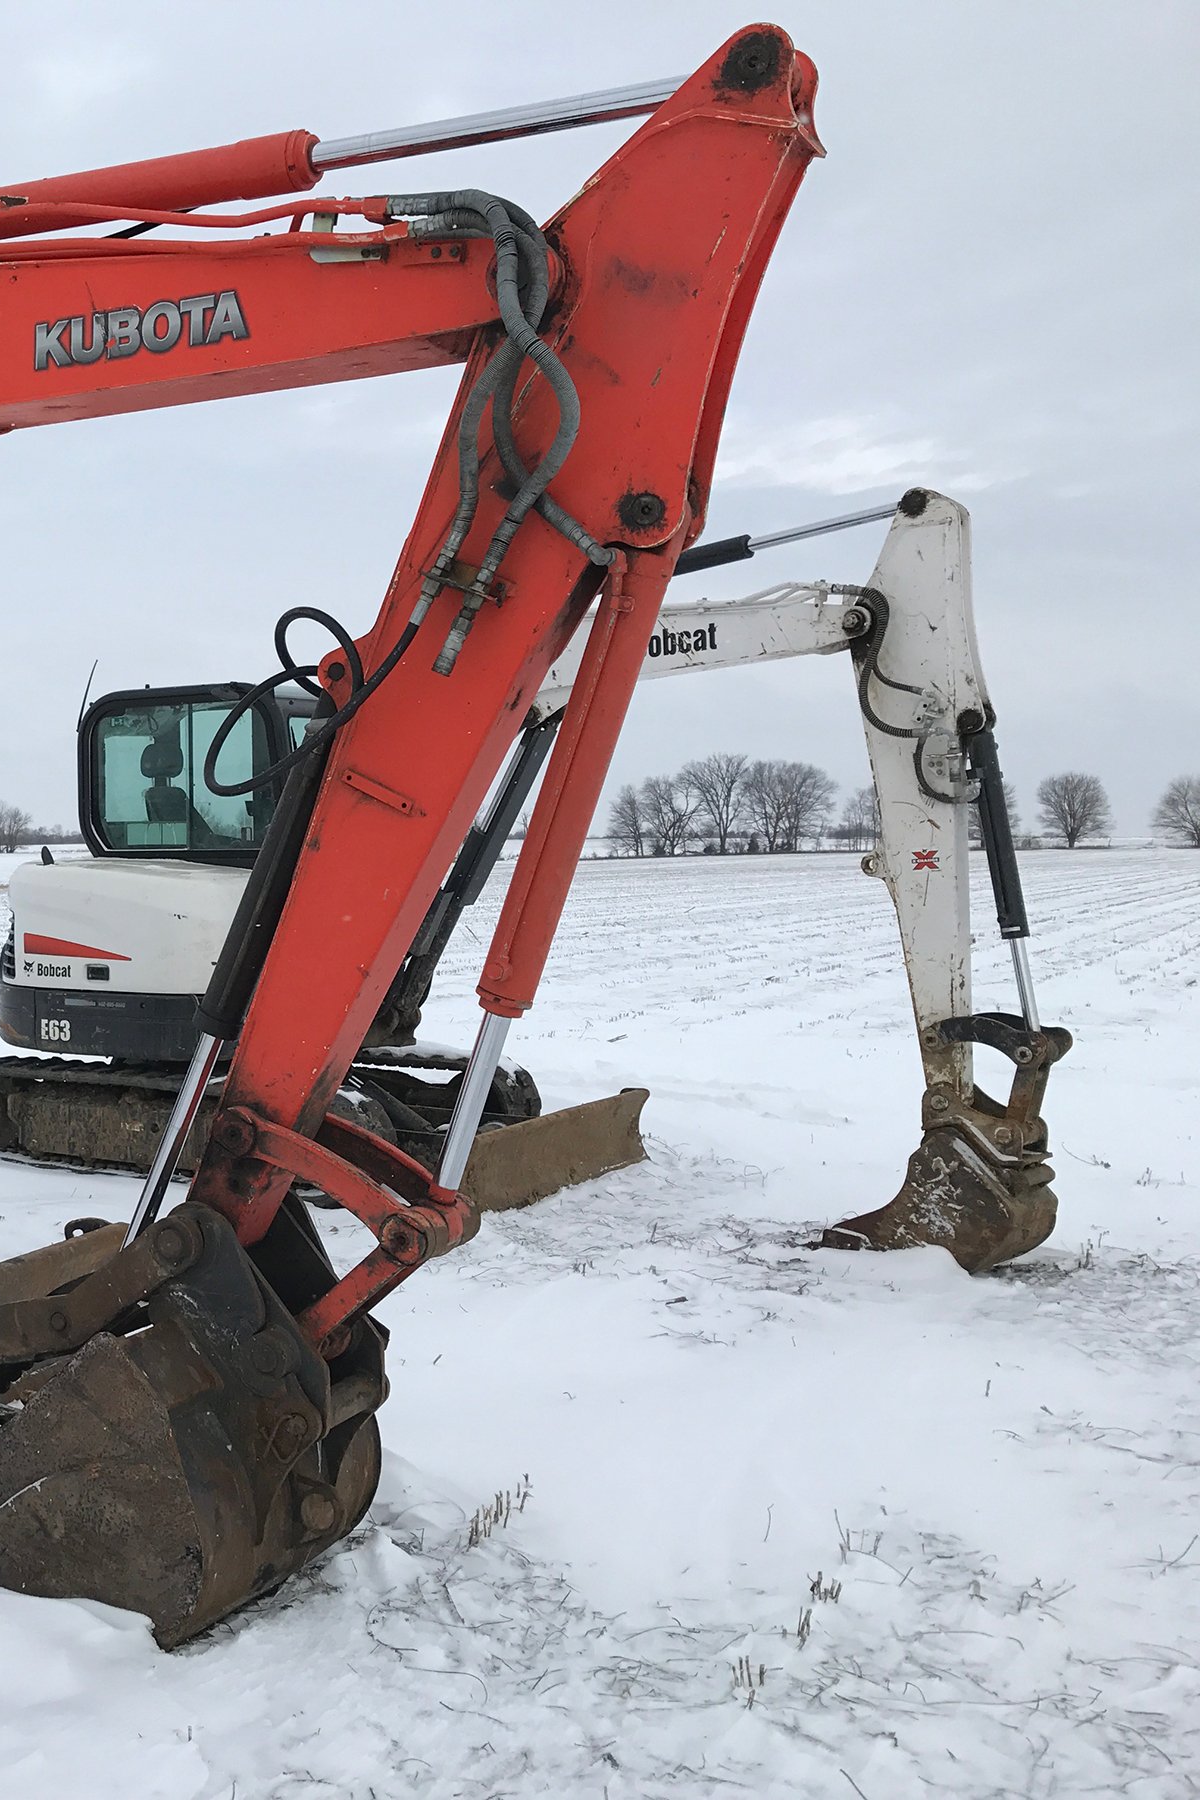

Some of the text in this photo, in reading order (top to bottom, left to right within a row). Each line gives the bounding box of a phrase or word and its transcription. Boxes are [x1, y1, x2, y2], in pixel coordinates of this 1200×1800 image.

[33, 290, 250, 371] KUBOTA
[647, 622, 718, 658] obcat
[37, 963, 72, 978] Bobcat
[40, 1018, 71, 1042] E63
